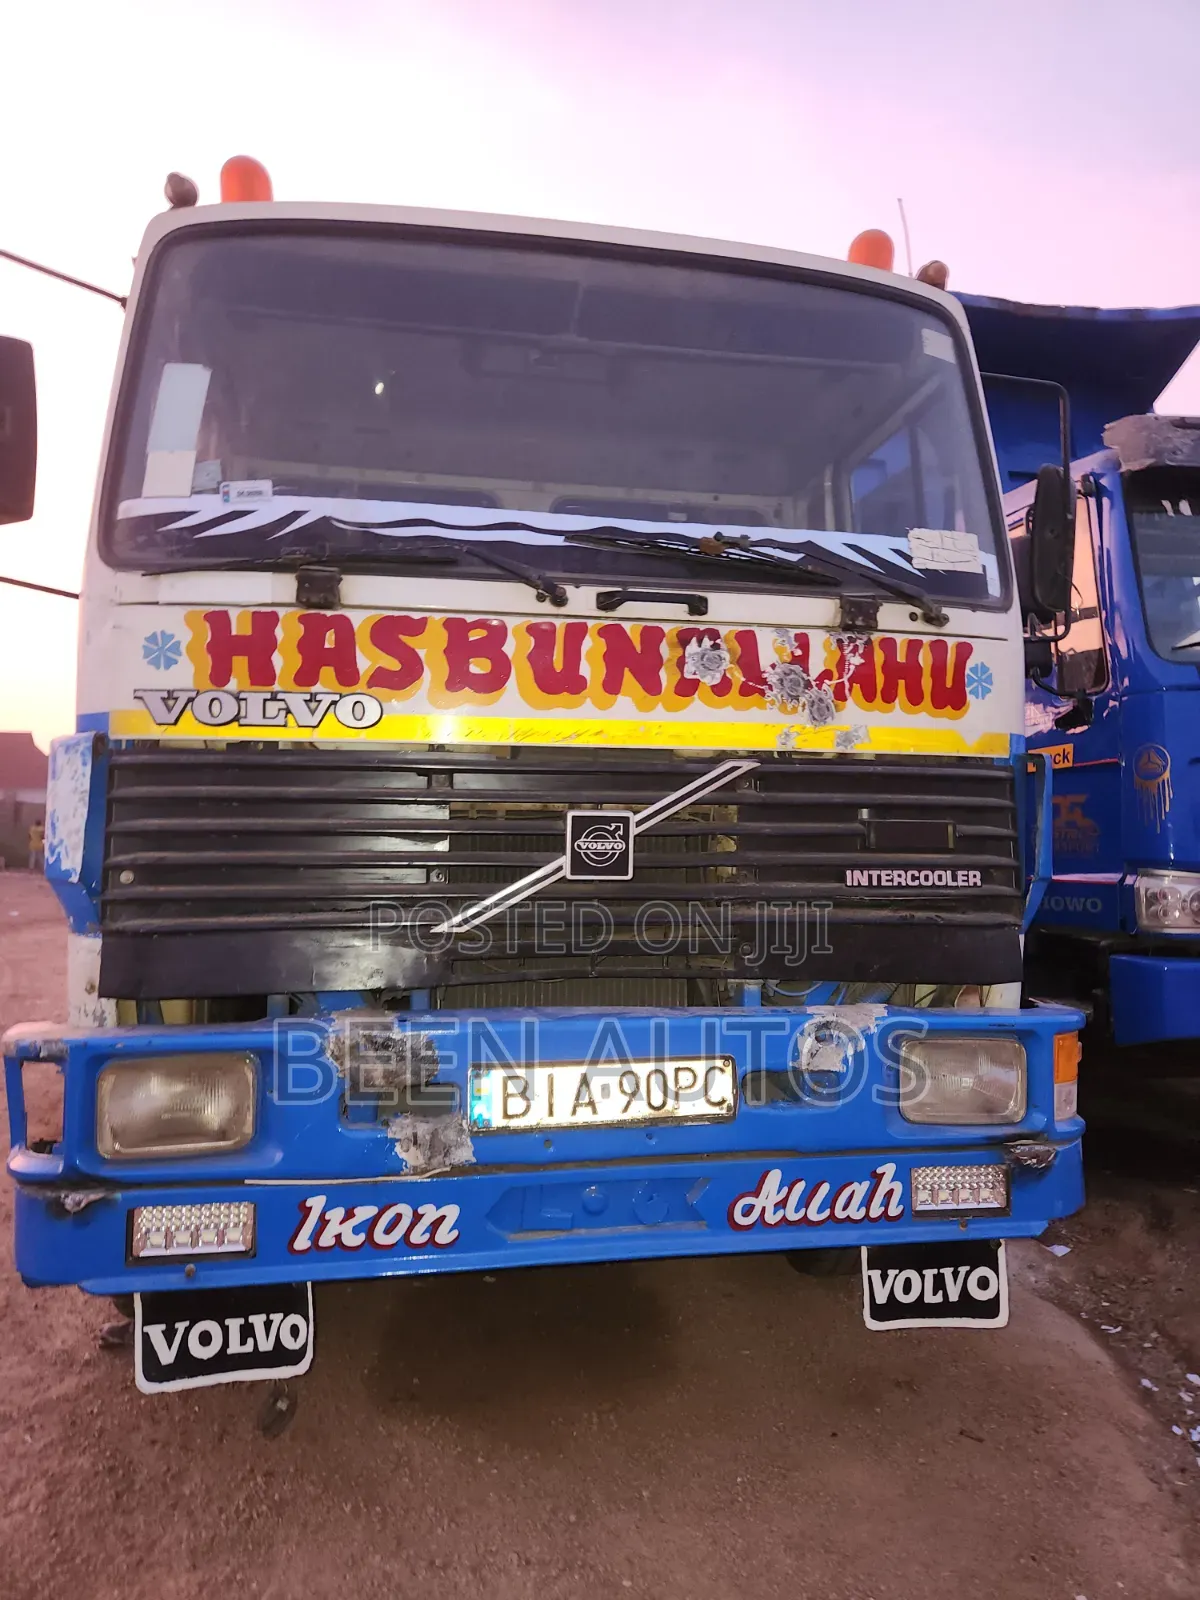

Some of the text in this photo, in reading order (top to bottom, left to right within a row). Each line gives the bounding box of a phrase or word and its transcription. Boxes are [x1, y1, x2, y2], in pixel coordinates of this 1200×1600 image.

[133, 688, 384, 730] VOLVO
[577, 842, 623, 850] VOLVO
[845, 869, 982, 887] INTERCOOLER
[618, 1065, 728, 1114] 90PC
[868, 1265, 999, 1305] VOLVO
[143, 1312, 308, 1366] VOLVO
